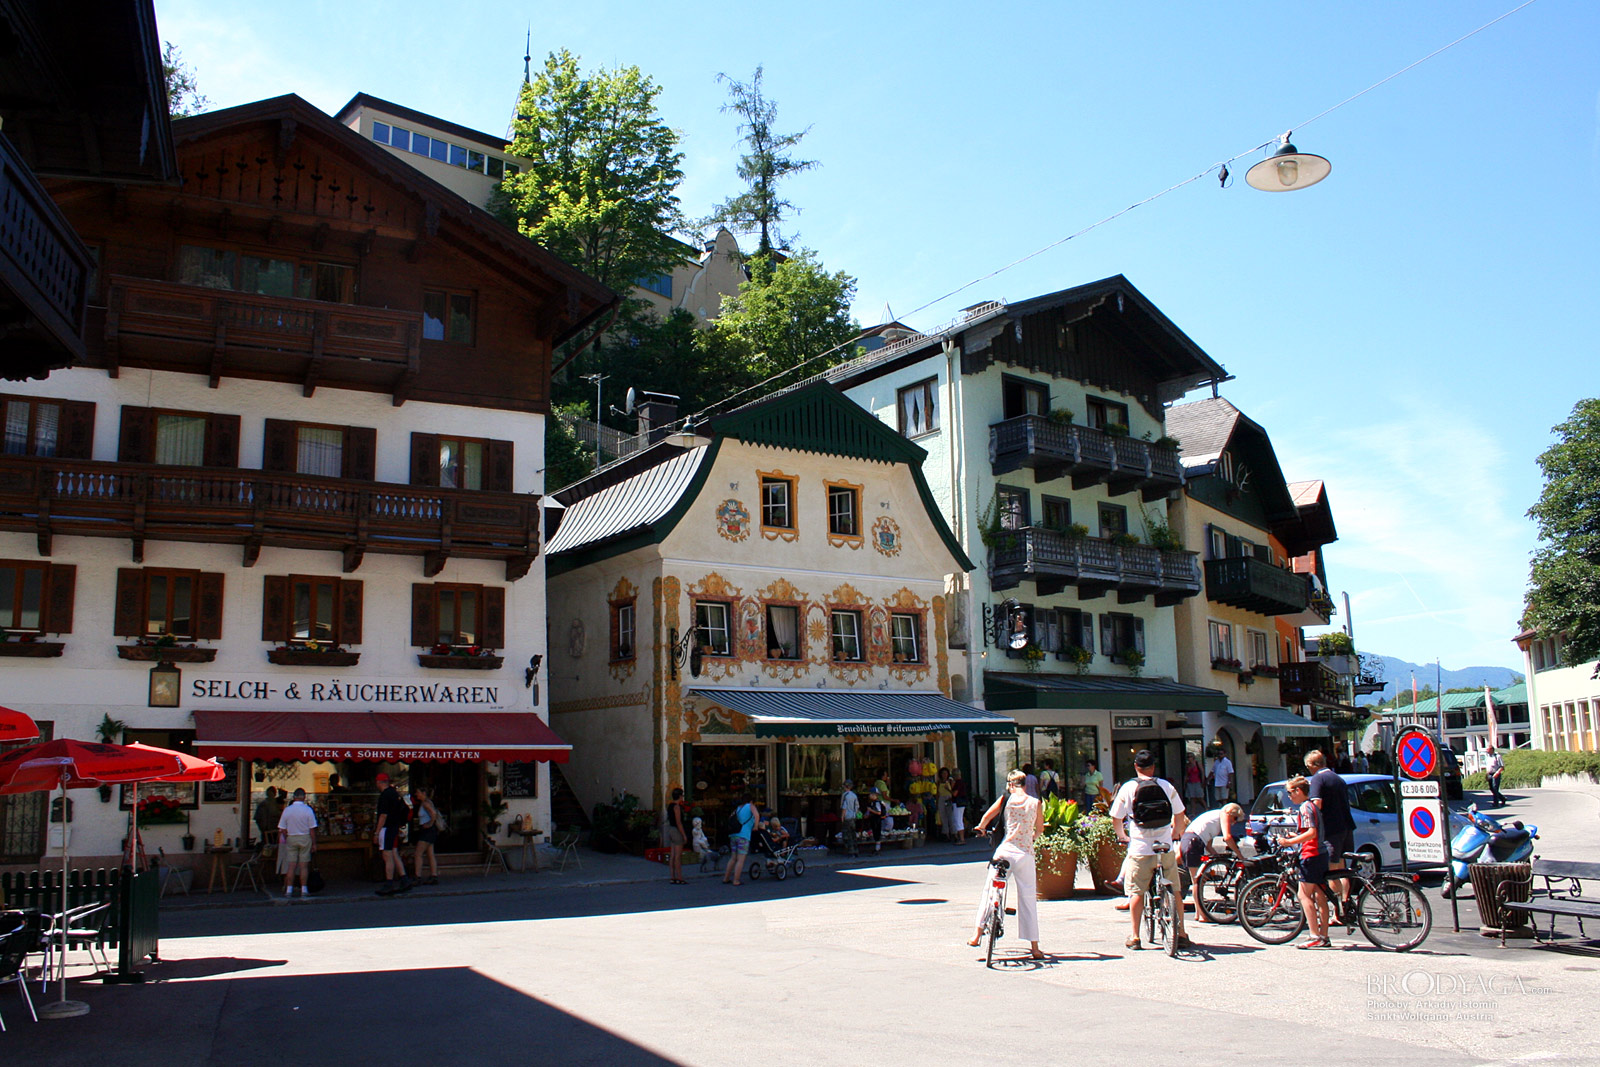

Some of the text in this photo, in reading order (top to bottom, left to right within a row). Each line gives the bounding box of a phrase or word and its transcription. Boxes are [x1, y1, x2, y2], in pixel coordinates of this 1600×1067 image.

[192, 679, 499, 704] SELCH- & RÄUCHERWAREN
[836, 724, 951, 733] Benediktiner Seifenmanufaktur
[301, 749, 480, 759] TUCEK & SÖHNE SPEZIALITÄTEN
